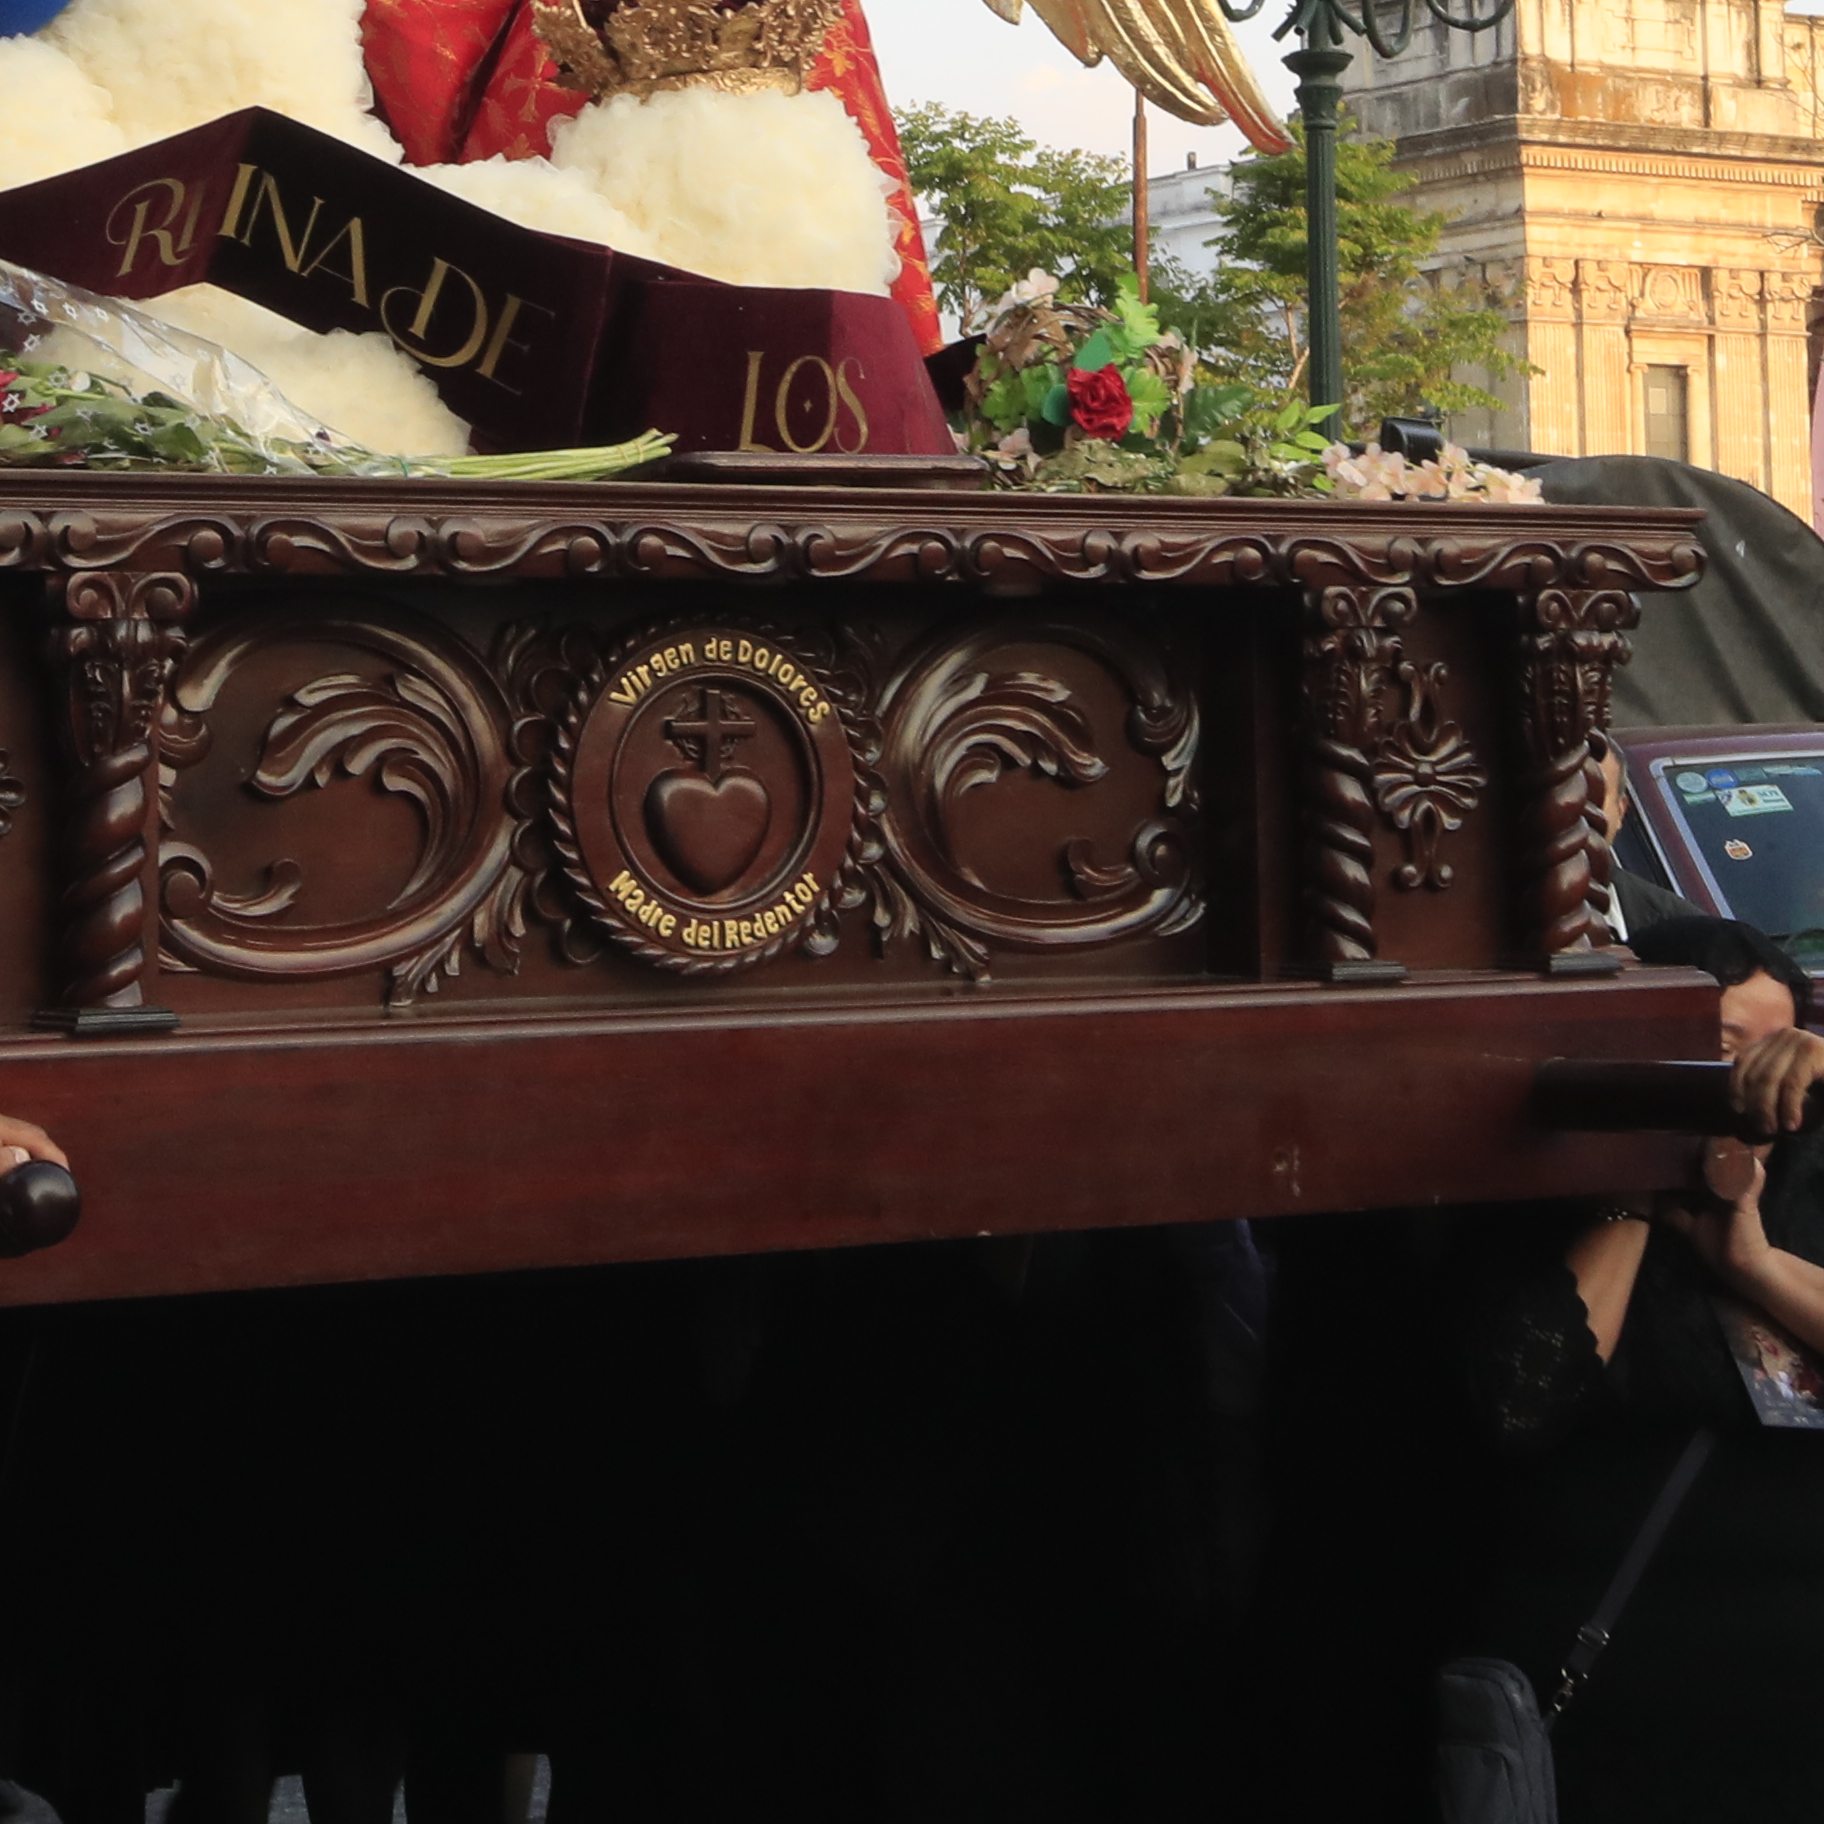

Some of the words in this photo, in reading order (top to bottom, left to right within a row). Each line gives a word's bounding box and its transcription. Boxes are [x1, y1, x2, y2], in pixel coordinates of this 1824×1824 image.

[380, 256, 556, 396] DE
[737, 350, 869, 454] LOS
[609, 642, 695, 705] Virgen
[704, 637, 733, 662] de
[737, 639, 830, 723] Dolores
[608, 870, 677, 937] Madre
[682, 919, 721, 949] del
[724, 872, 821, 949] Redentor
